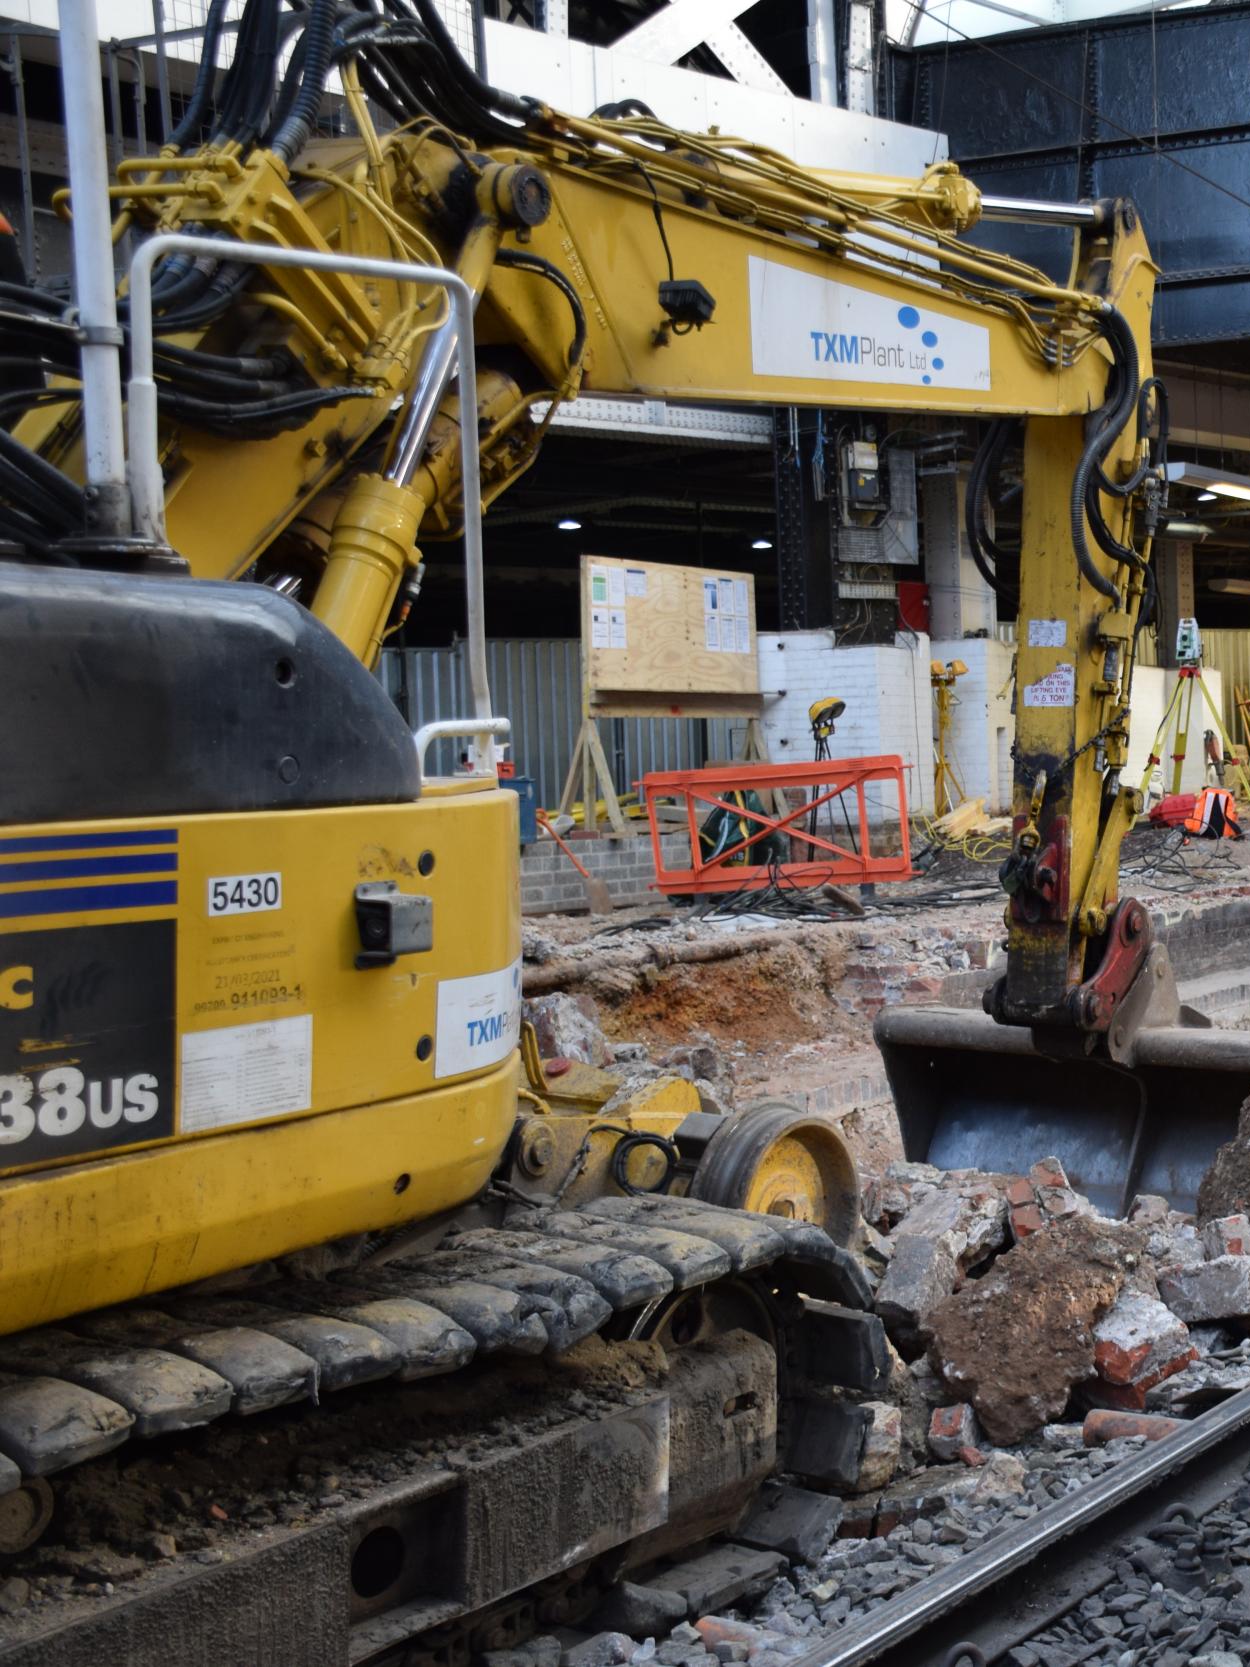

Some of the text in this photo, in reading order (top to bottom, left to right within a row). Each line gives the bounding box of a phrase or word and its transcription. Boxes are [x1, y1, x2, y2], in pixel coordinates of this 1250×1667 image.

[810, 331, 927, 370] TXMPlant Ltd
[212, 877, 279, 912] 5430
